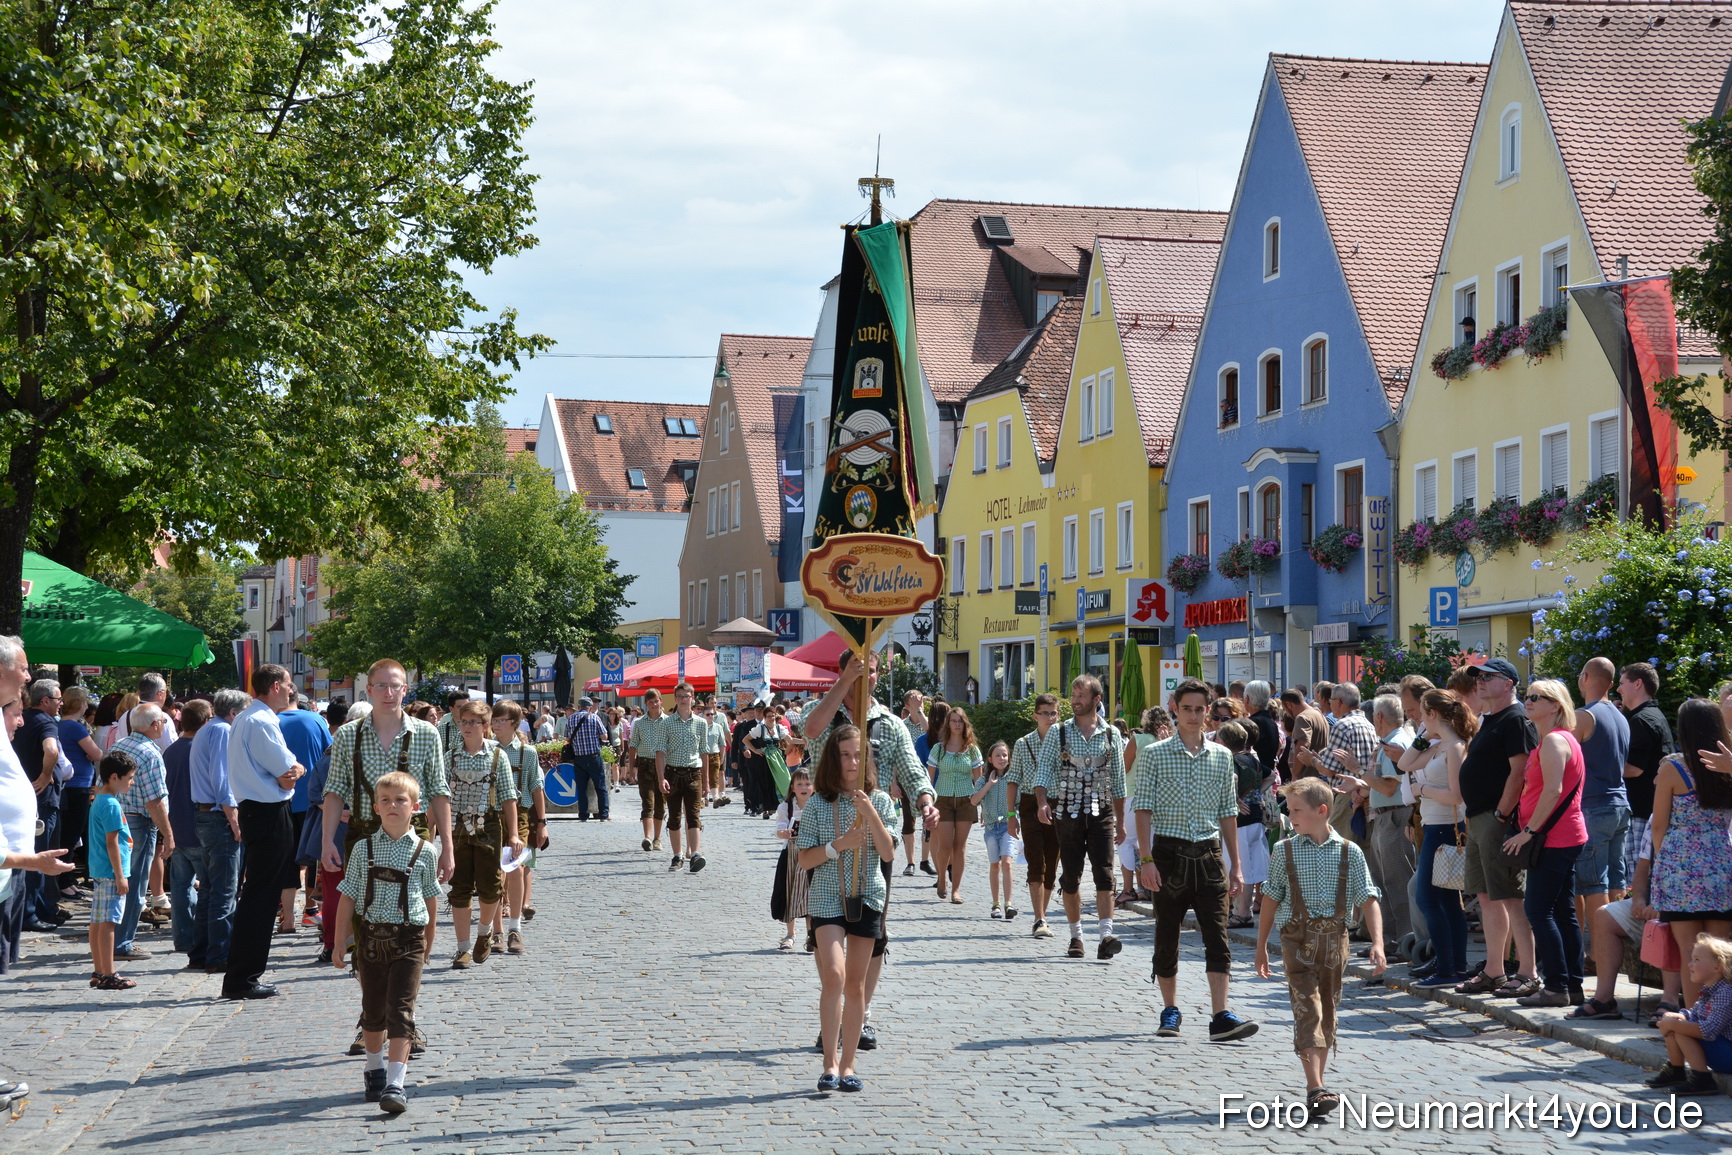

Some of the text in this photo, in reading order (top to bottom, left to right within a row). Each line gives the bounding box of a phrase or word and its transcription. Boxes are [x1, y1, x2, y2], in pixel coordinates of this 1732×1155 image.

[857, 322, 889, 343] unse
[986, 493, 1048, 522] HOTEL Lehmeier
[1369, 498, 1388, 514] CAFÉ
[1370, 517, 1386, 595] WITTL
[857, 565, 923, 594] SV Wolfstein
[1040, 568, 1046, 592] P
[1078, 593, 1083, 617] P
[1183, 597, 1248, 628] APOTHEKE
[1436, 591, 1452, 622] P
[983, 617, 1020, 634] Restaurant
[603, 673, 622, 681] TAXI
